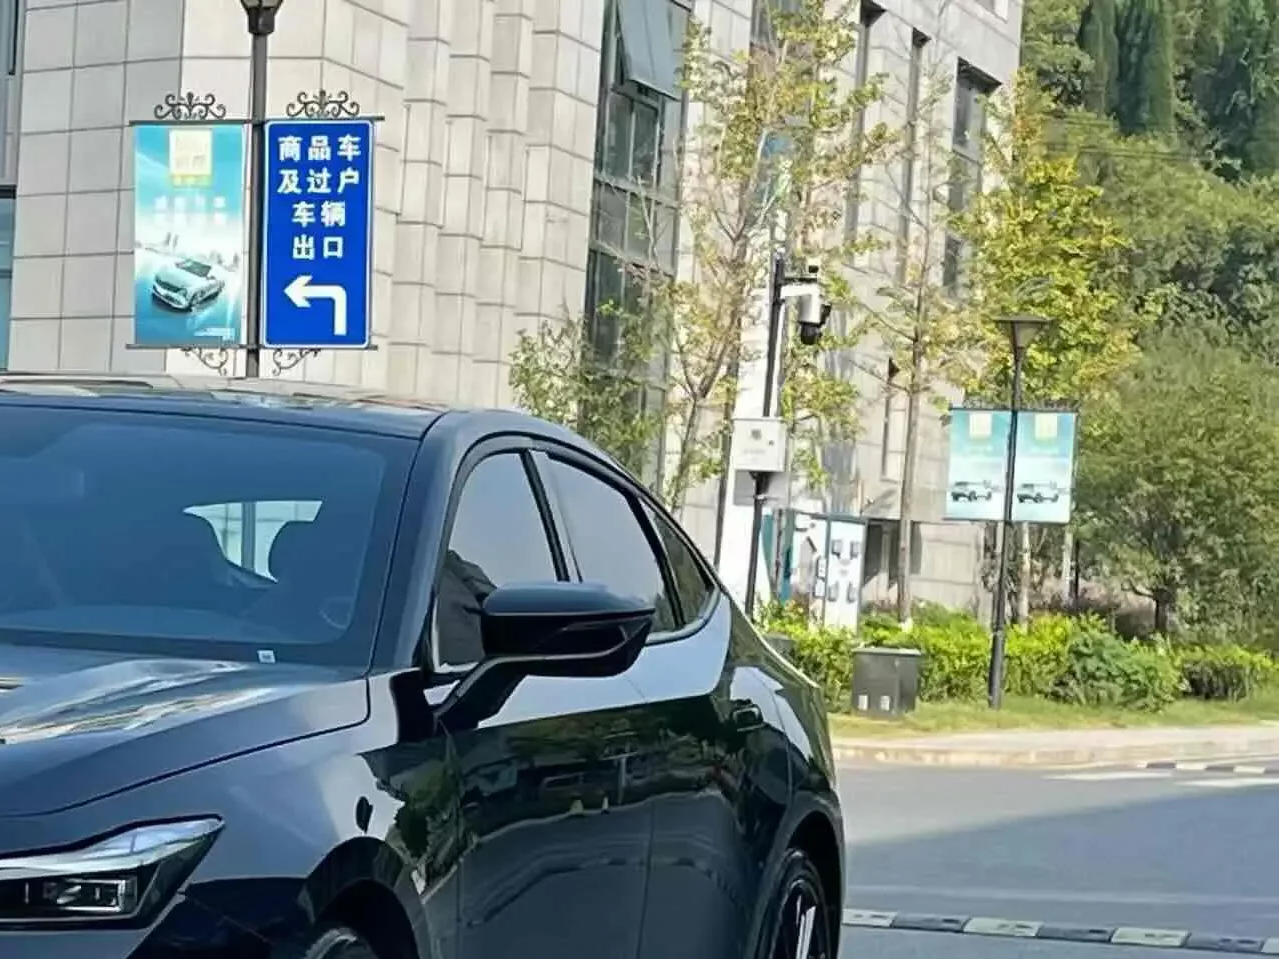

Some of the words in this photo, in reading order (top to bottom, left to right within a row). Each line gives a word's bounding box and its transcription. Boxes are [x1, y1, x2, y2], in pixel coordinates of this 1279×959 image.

[277, 134, 362, 162] 商品车
[277, 166, 360, 194] 及过户
[291, 200, 346, 228] 车辆
[292, 234, 344, 260] 出口
